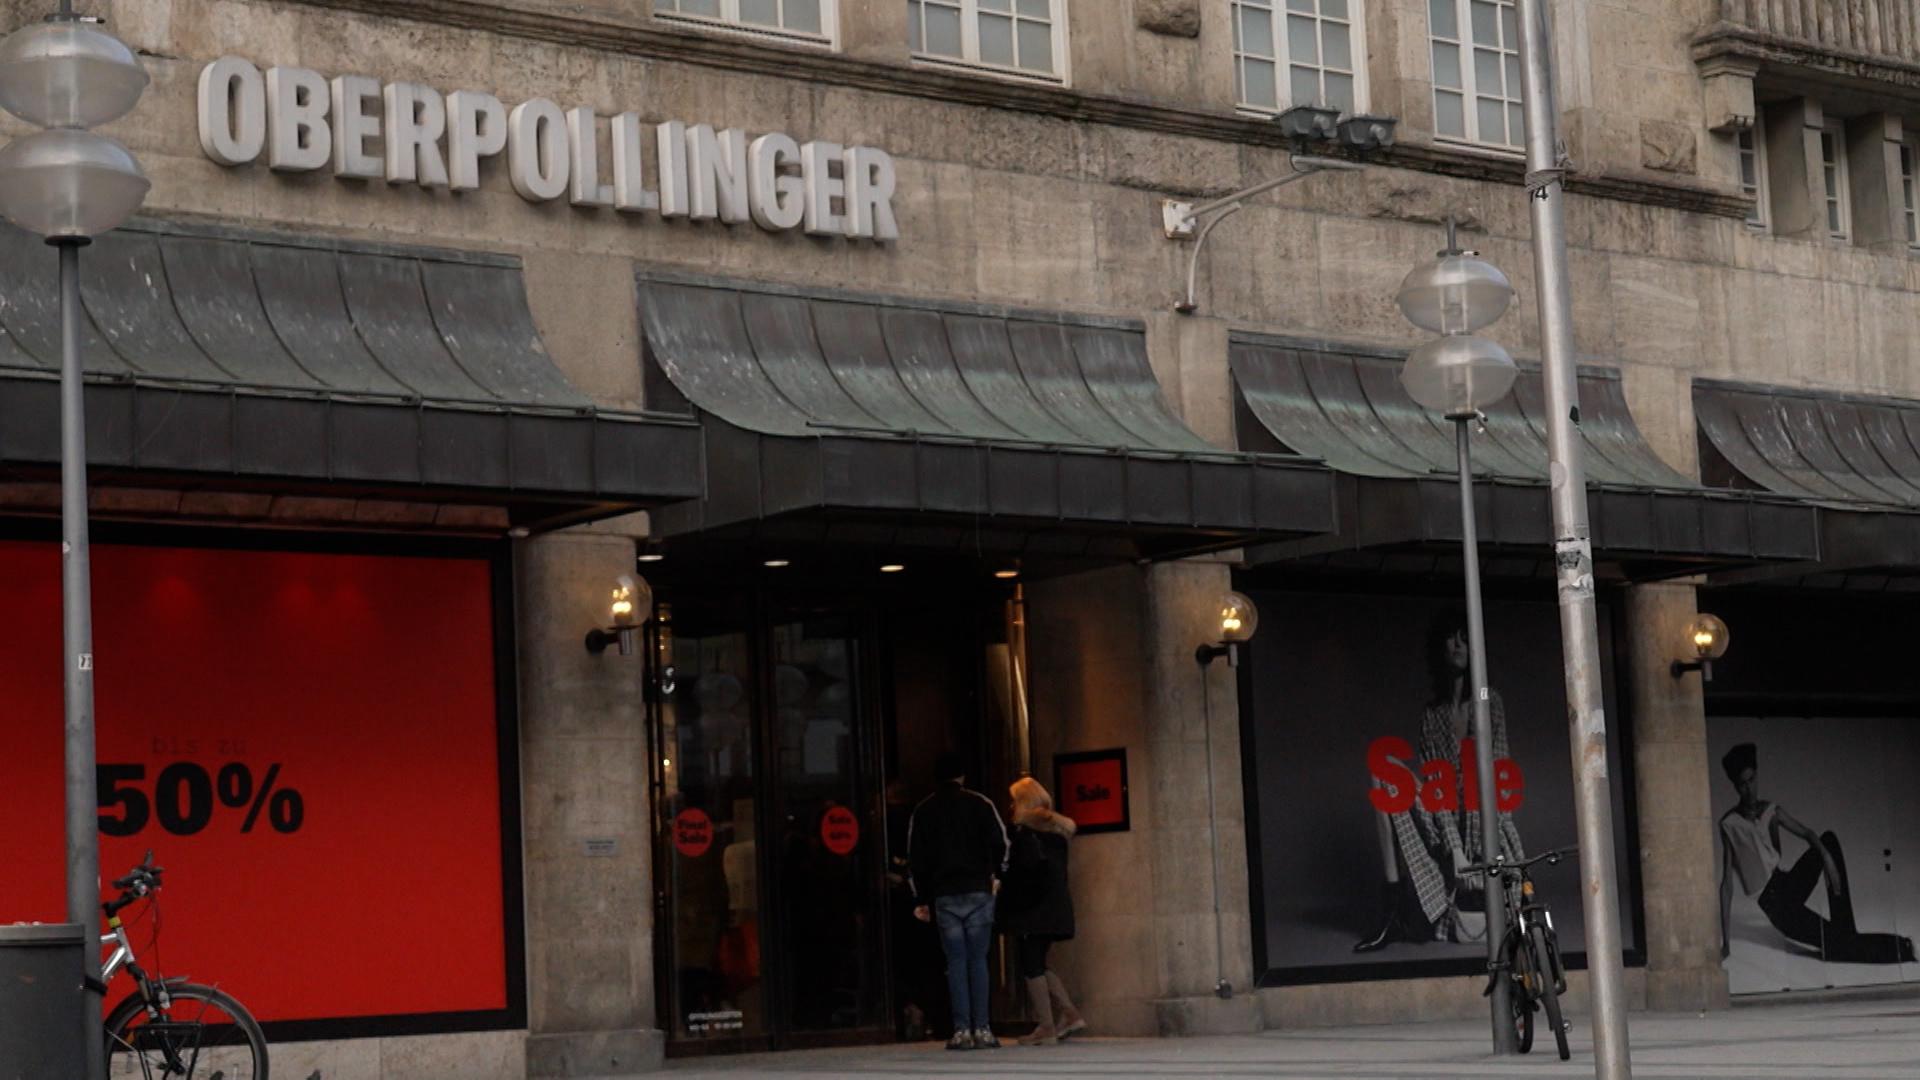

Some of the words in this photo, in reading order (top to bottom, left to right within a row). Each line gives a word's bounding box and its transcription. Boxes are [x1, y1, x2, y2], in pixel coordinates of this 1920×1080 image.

[197, 55, 898, 240] OBERPOLLINGER
[97, 761, 304, 836] 50%
[1077, 784, 1110, 803] Sale
[1367, 736, 1525, 813] Sale
